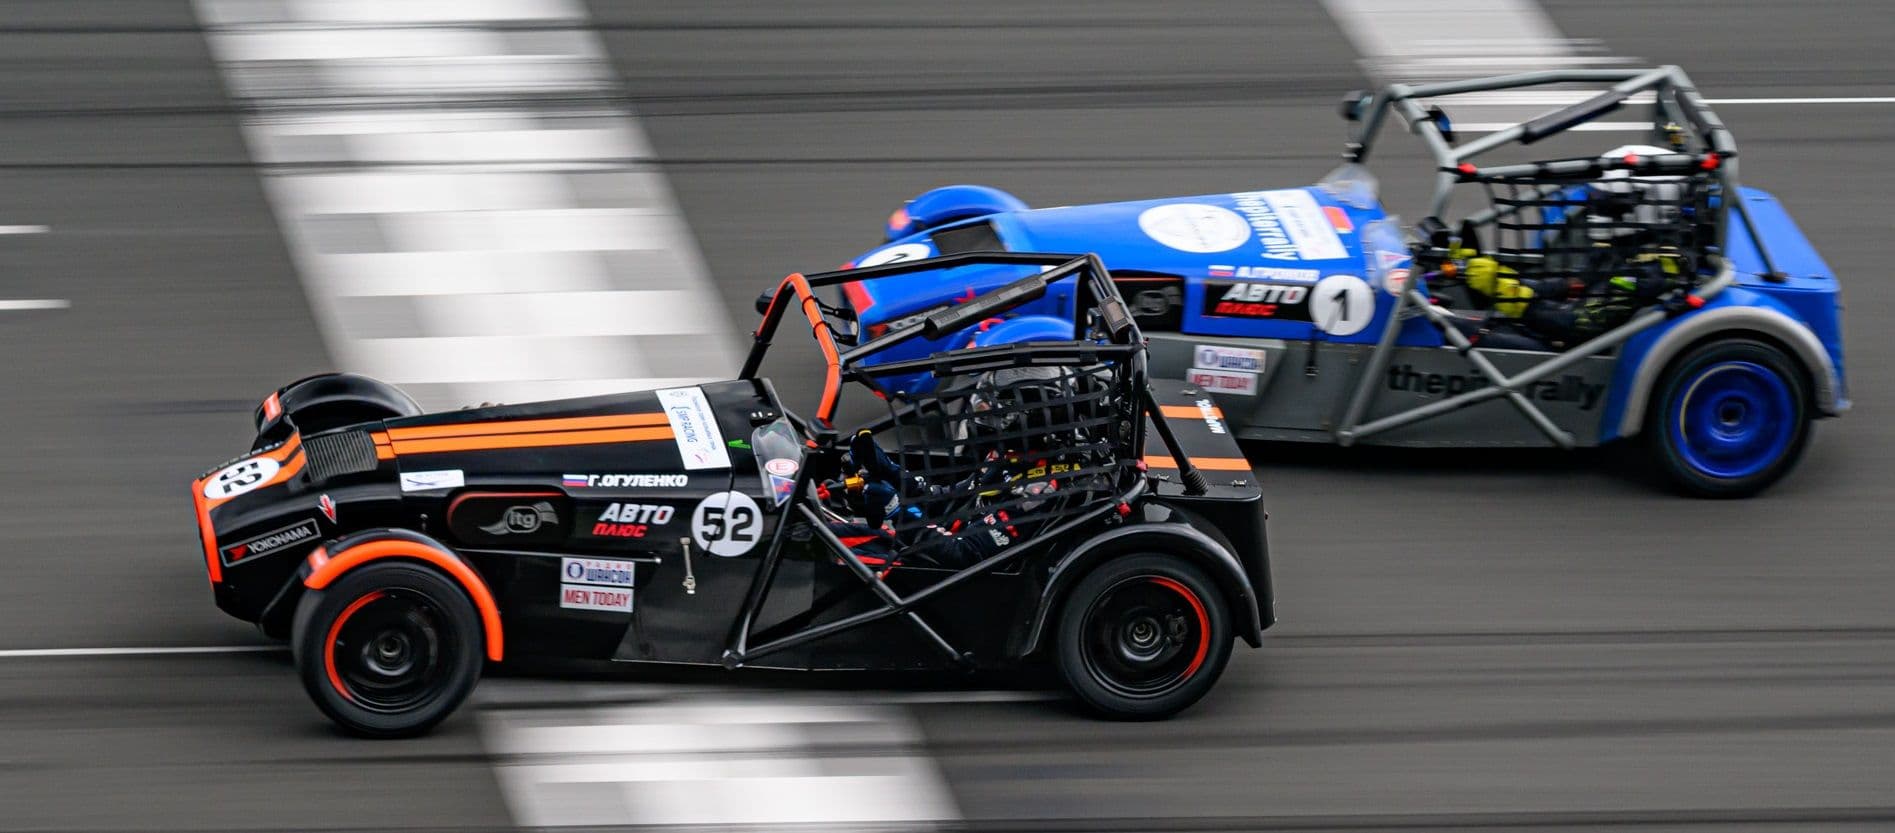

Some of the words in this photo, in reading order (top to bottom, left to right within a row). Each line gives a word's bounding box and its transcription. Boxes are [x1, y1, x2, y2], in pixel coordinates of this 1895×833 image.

[1221, 282, 1308, 305] АВТО
[1331, 288, 1350, 321] 1
[219, 461, 263, 494] 52
[587, 474, 688, 487] Г.ОГУЛЕНКО
[510, 511, 536, 529] itg
[598, 502, 675, 525] АВТО
[701, 506, 754, 542] 52
[247, 526, 312, 554] YOKOHAMA
[592, 522, 648, 537] ПЛЮС
[564, 589, 589, 604] MEN
[592, 591, 629, 607] TODAY
